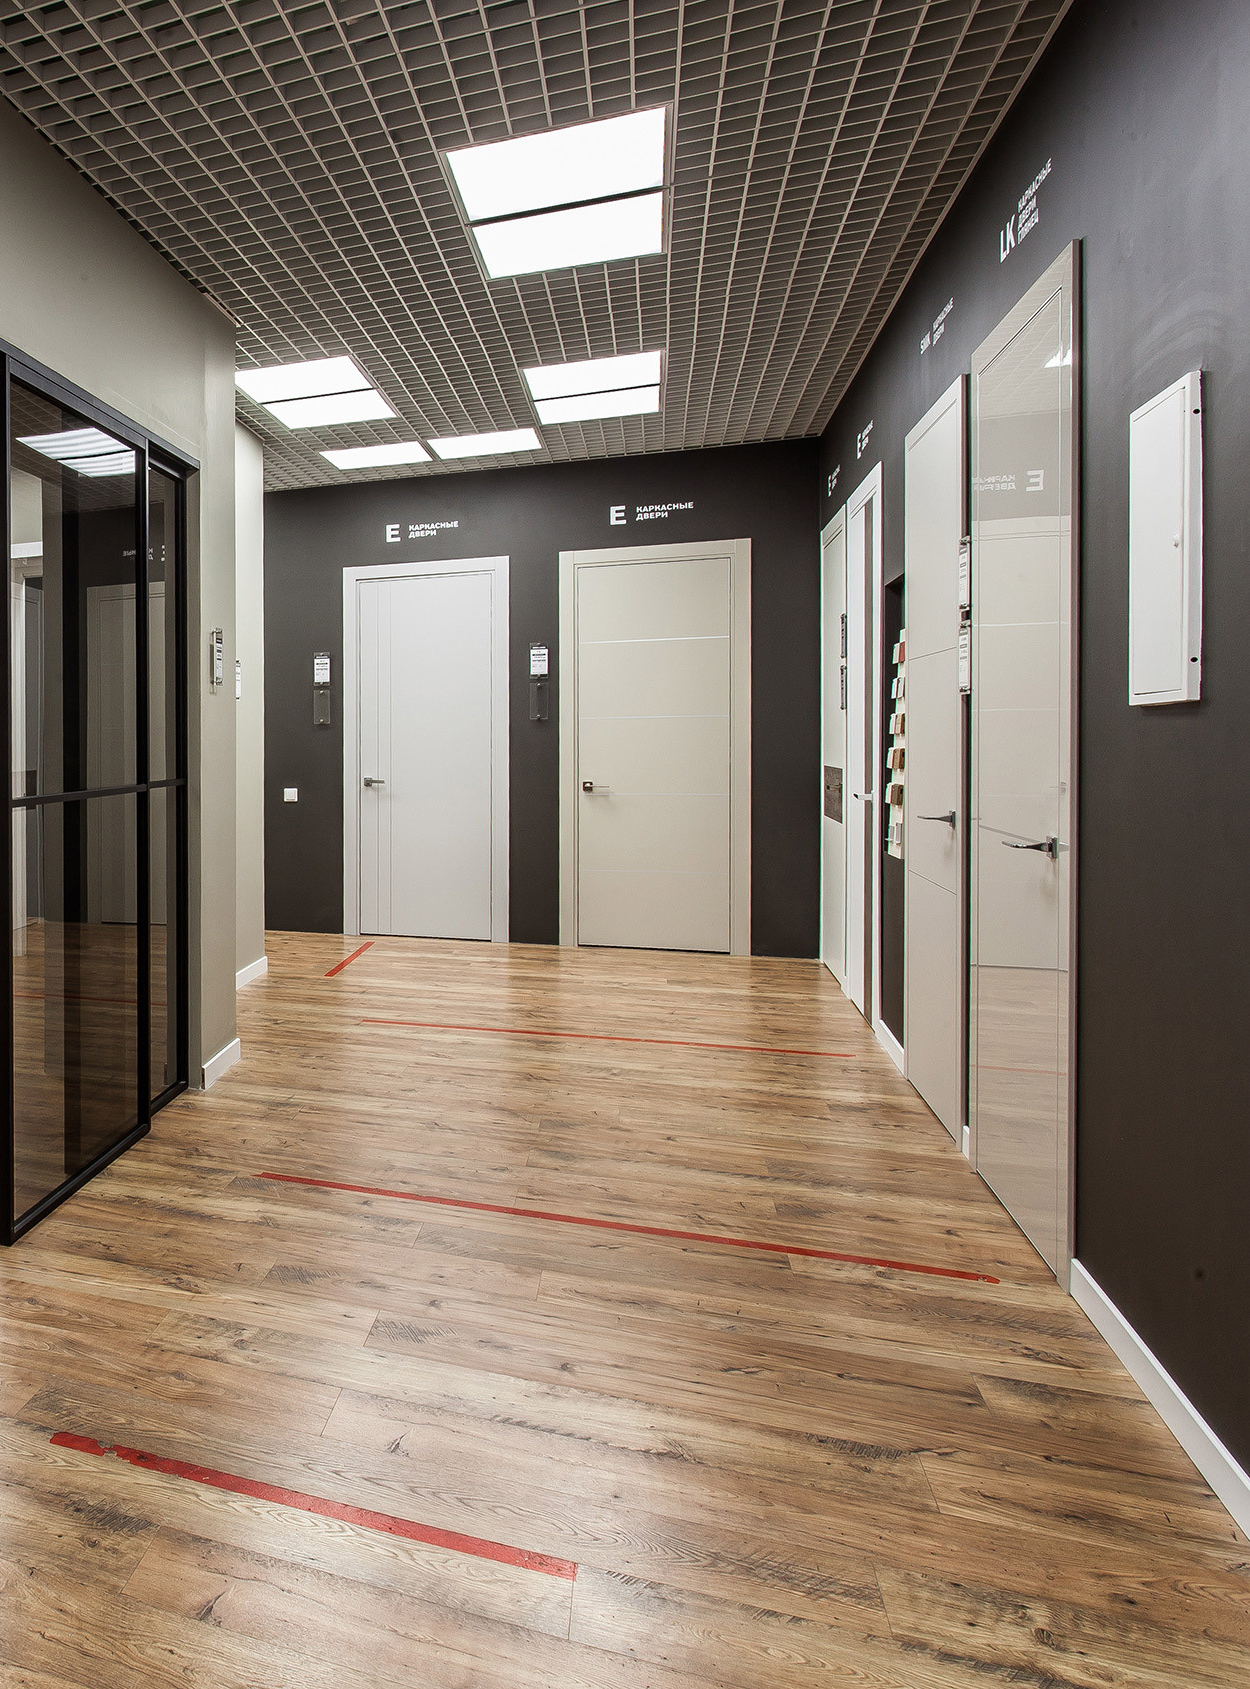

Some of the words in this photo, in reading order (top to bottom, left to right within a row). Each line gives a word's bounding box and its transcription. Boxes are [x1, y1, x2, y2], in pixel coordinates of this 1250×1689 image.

[1000, 213, 1016, 263] LK
[636, 501, 694, 513] КАРКАСНЫЕ
[610, 505, 627, 525] E
[635, 511, 668, 521] ДВЕРИ
[408, 520, 459, 531] КАРКАСНЫЕ
[385, 523, 402, 543] E
[408, 529, 437, 539] ДВЕРИ
